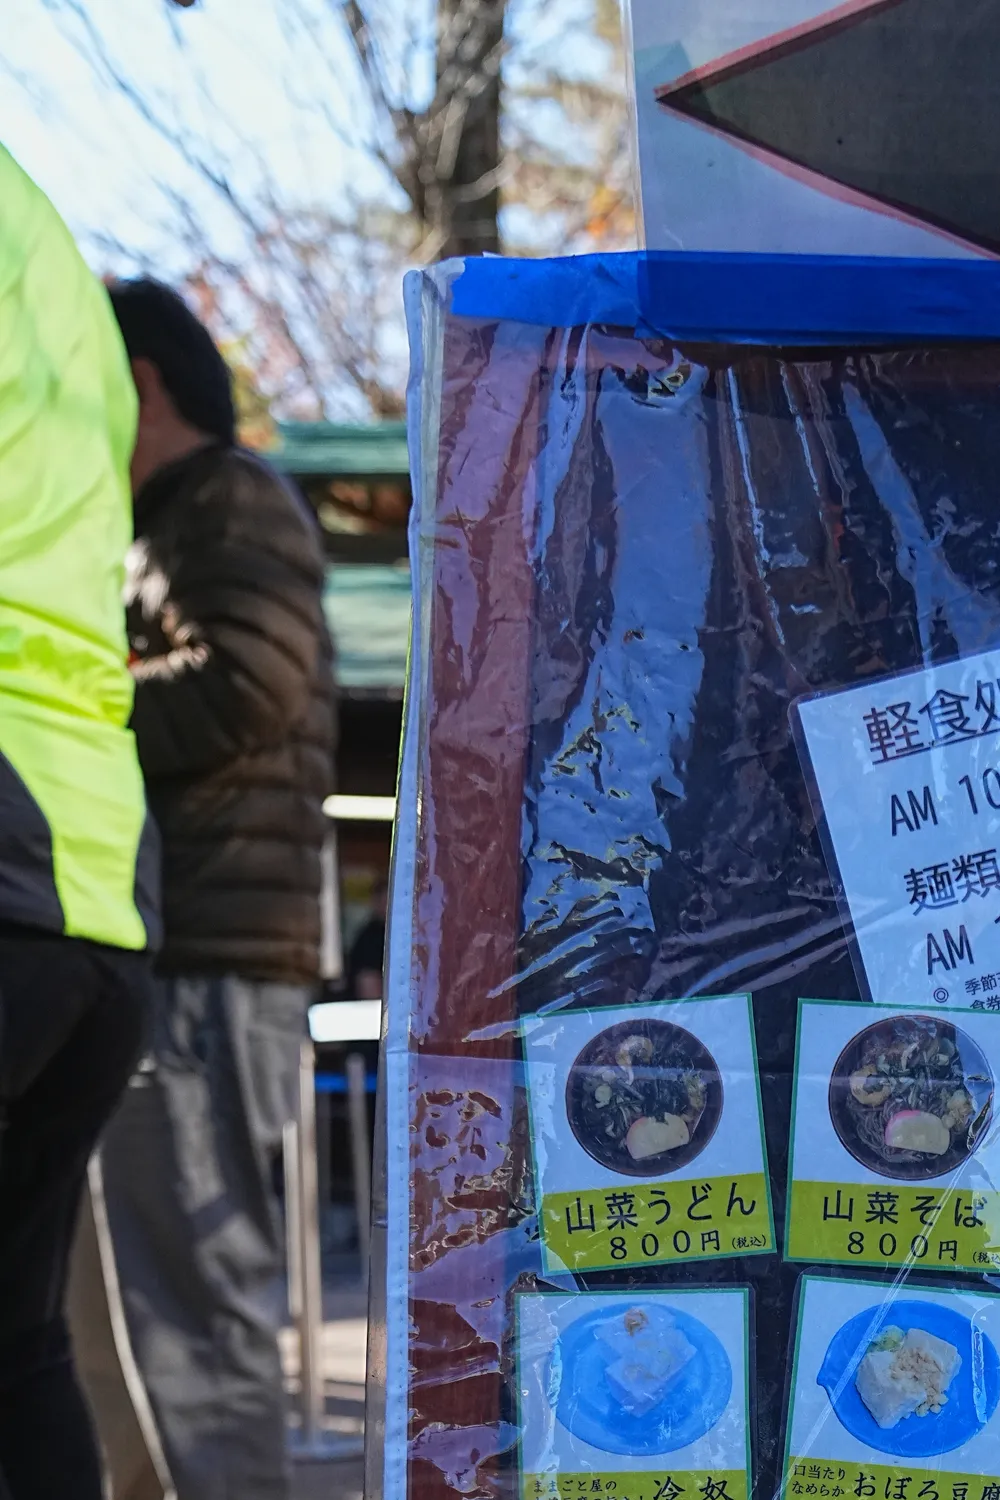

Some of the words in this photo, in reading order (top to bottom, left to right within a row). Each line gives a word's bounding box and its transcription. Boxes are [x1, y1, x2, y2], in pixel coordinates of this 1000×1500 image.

[889, 786, 937, 836] AM
[926, 925, 975, 976] AM
[565, 1182, 756, 1234] 山菜うどん
[823, 1190, 988, 1228] 山菜そば
[610, 1229, 720, 1259] 800円
[731, 1234, 767, 1249] (税込)
[847, 1231, 958, 1260] 800円
[532, 1478, 617, 1493] ままごと屋の
[793, 1464, 846, 1481] 口当たり
[792, 1480, 845, 1498] なめらか
